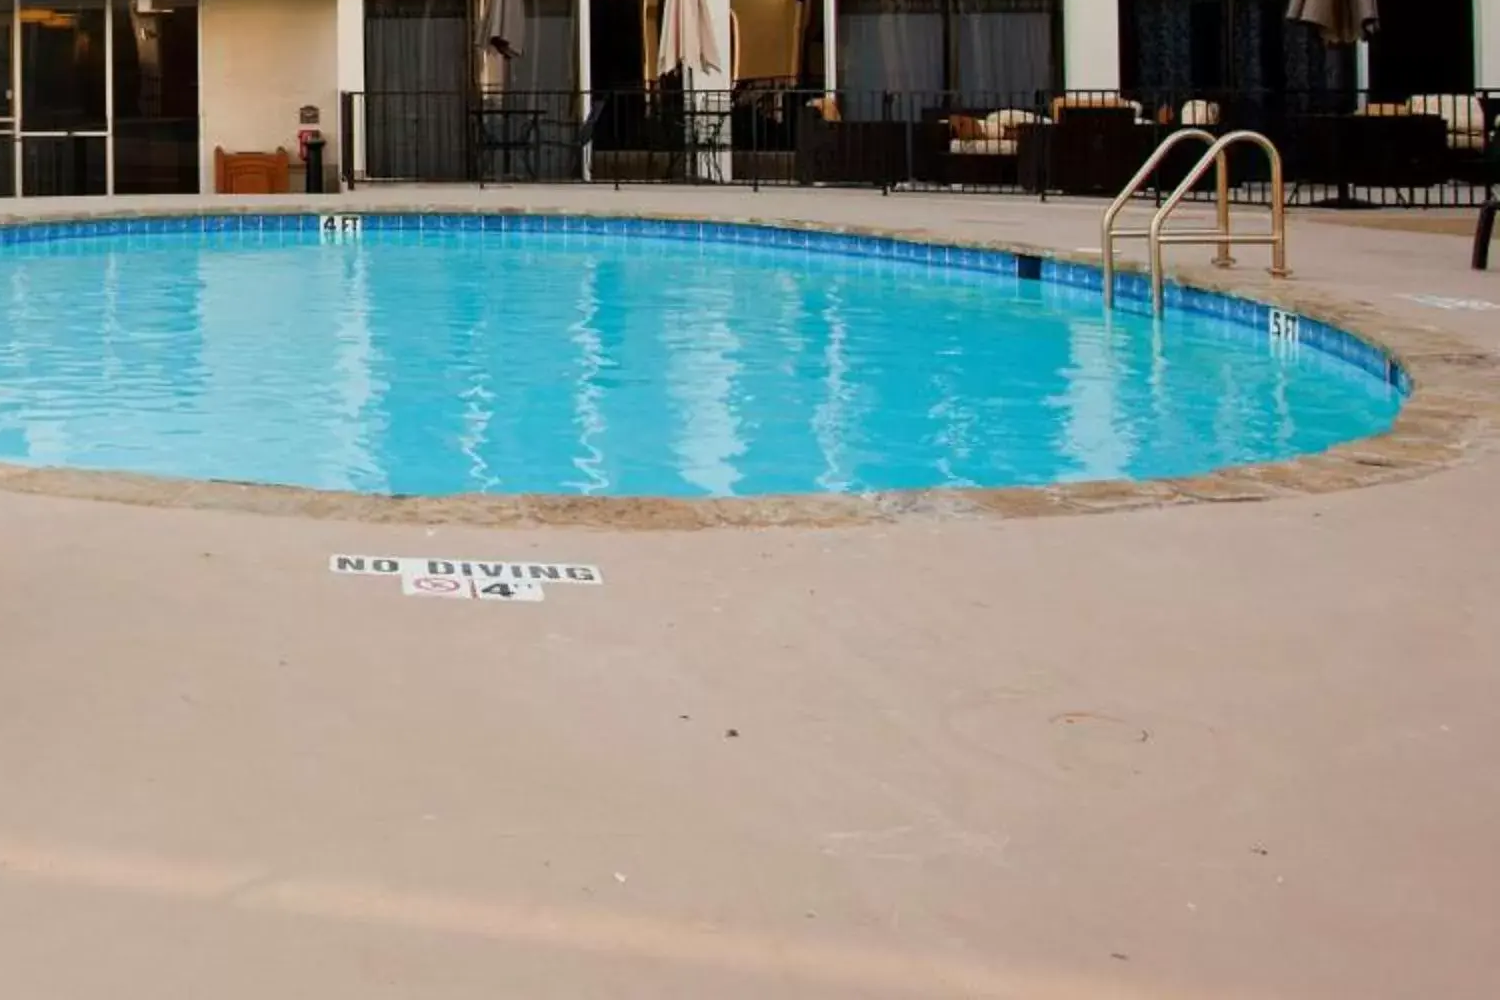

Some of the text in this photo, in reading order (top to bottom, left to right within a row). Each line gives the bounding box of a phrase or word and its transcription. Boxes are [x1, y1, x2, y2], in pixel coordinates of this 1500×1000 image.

[323, 216, 359, 232] 4 FT
[1271, 311, 1281, 337] 5
[336, 556, 596, 581] NO DIVING
